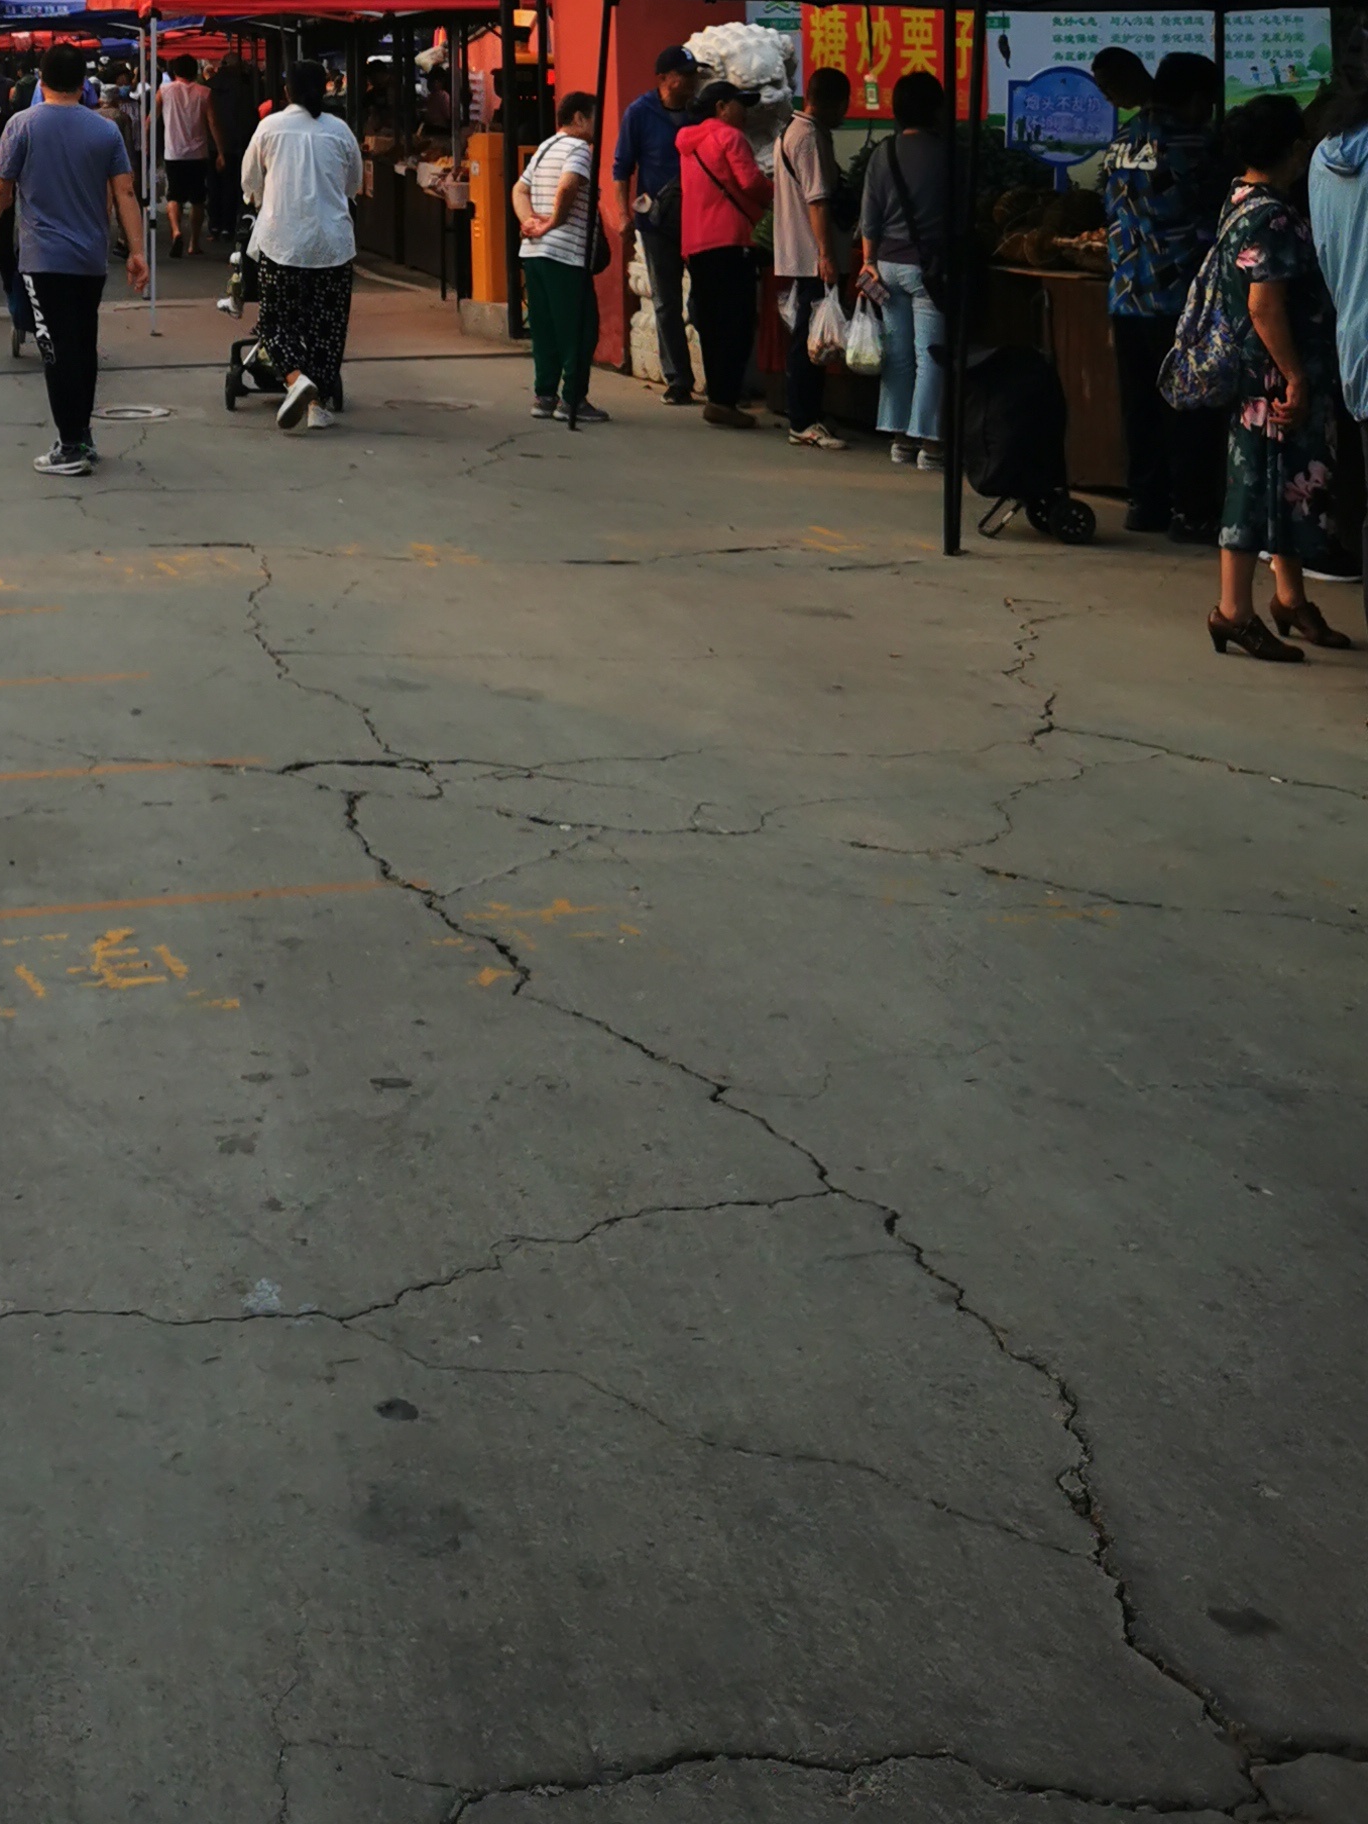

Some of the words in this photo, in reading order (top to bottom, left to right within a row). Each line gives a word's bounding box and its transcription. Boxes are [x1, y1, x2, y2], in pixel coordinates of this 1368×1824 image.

[809, 4, 975, 80] 糖炒栗子
[1104, 141, 1158, 171] FILA
